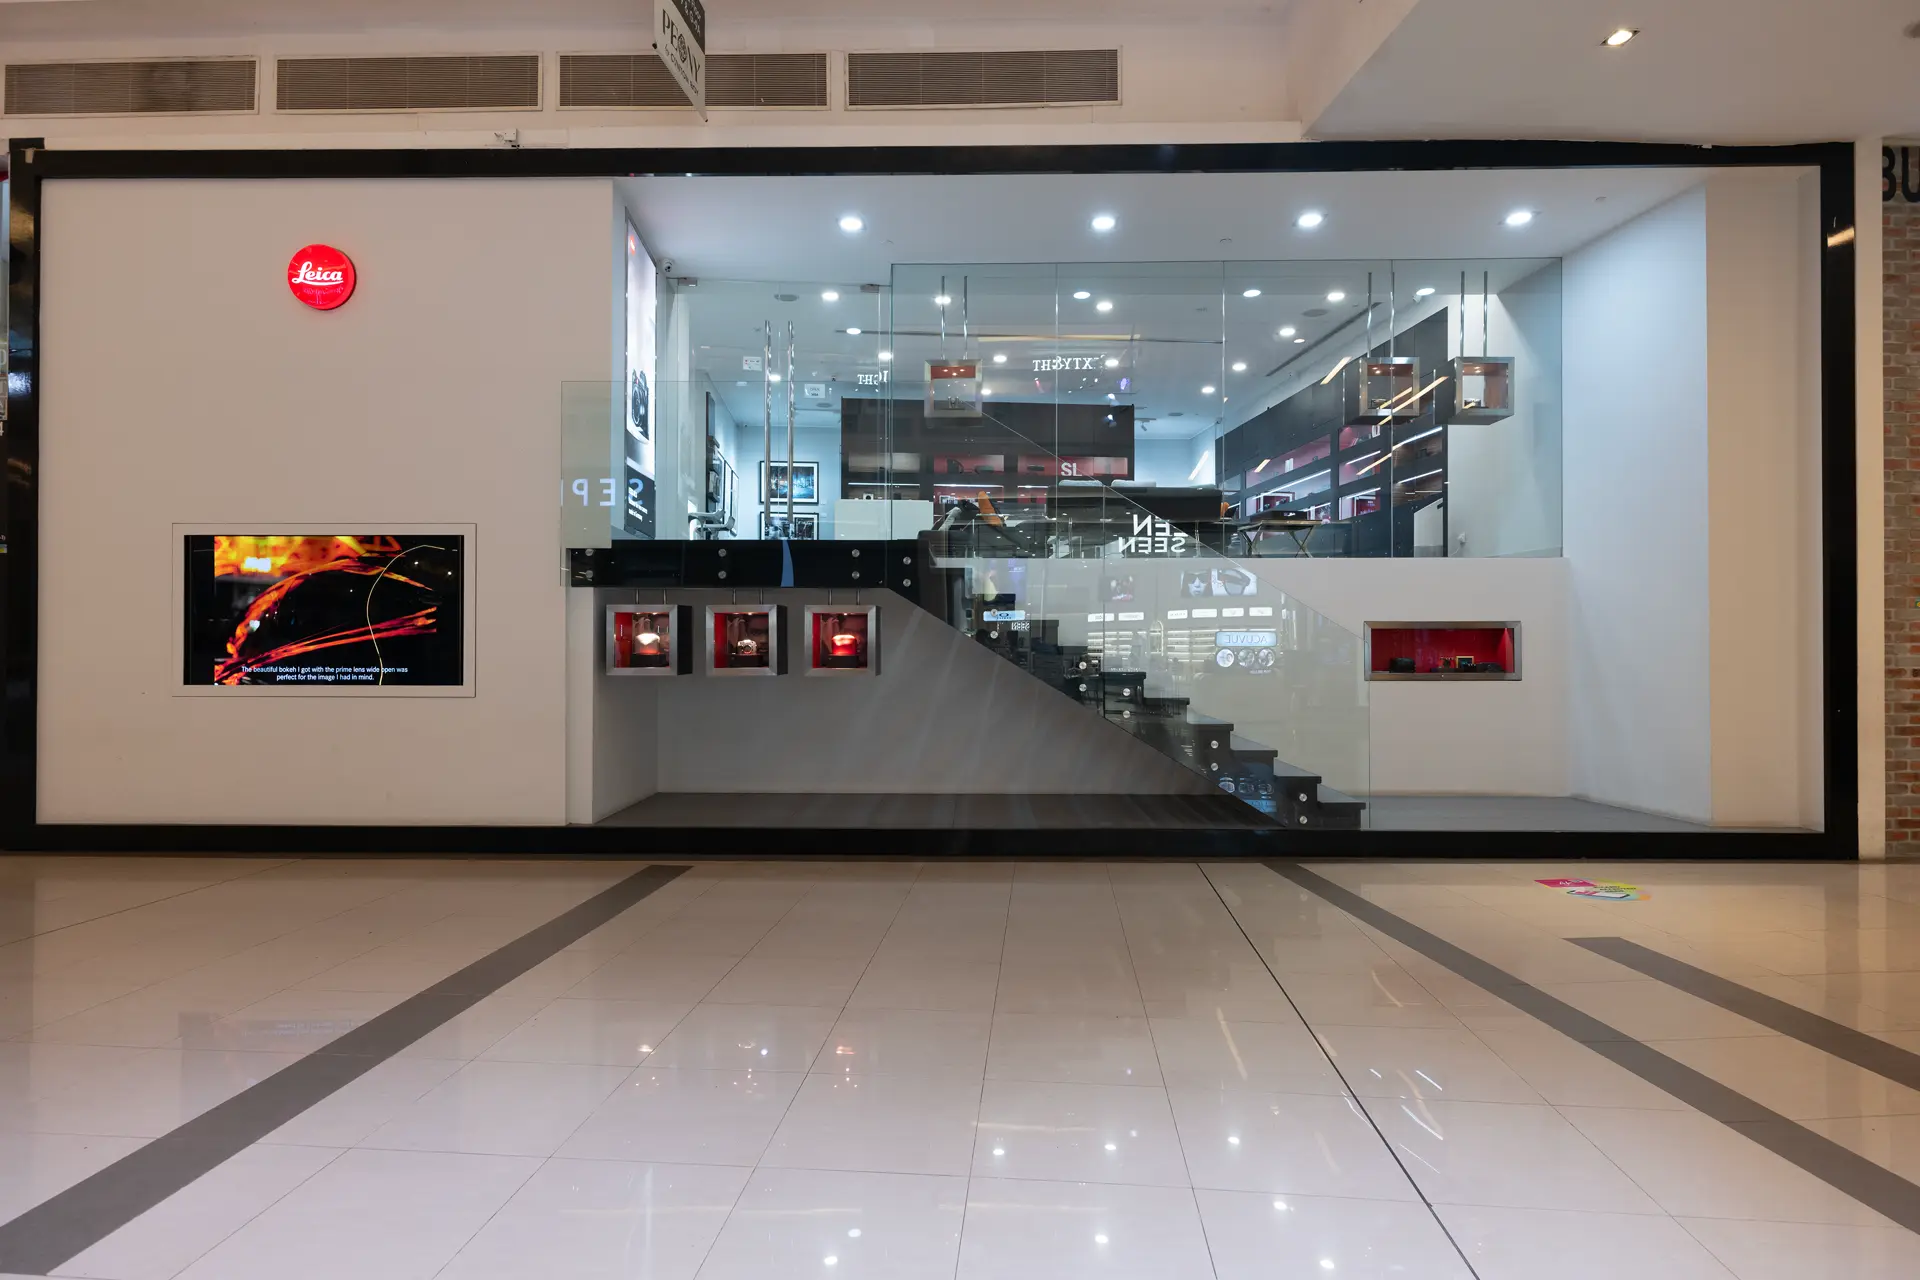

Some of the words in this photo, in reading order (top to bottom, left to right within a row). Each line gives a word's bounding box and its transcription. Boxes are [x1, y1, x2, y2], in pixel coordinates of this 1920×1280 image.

[291, 261, 344, 286] Leica
[1060, 461, 1083, 477] SL
[336, 666, 352, 674] prime
[318, 674, 335, 682] image
